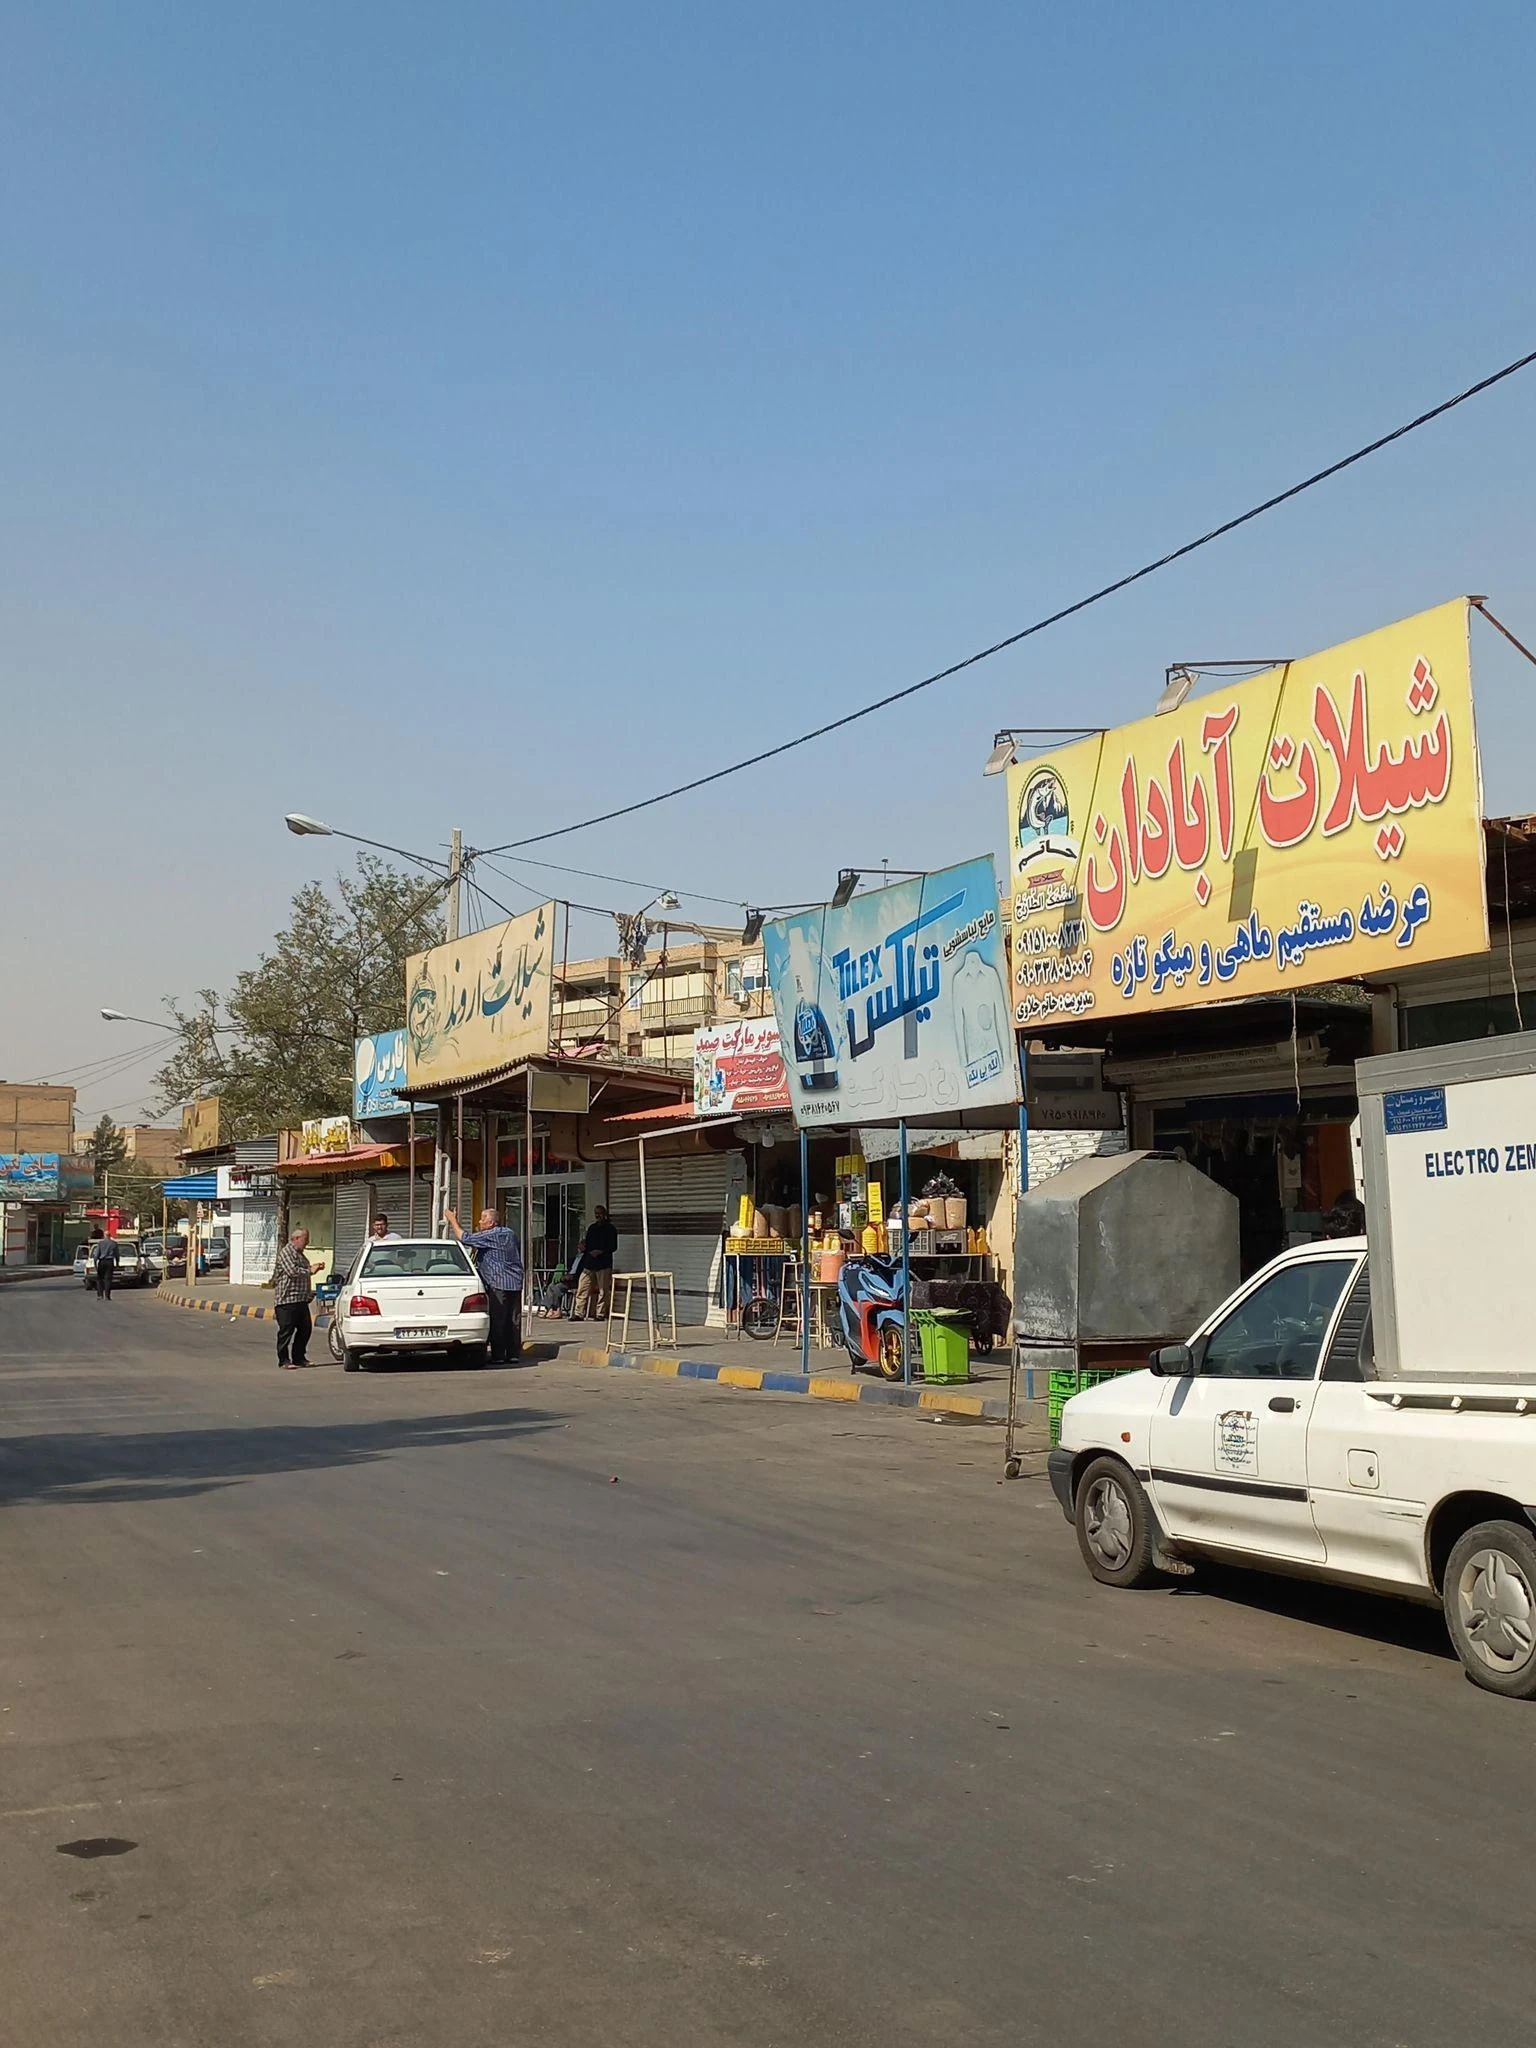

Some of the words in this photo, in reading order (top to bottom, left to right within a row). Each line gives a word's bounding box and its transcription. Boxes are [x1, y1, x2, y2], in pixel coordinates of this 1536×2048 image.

[1259, 656, 1451, 858] شیلات
[1086, 703, 1239, 930] آبادان
[1019, 839, 1077, 872] حاتم
[977, 911, 995, 938] مایع
[1215, 912, 1271, 978] ماهی
[1279, 899, 1354, 968] مستقیم
[1358, 884, 1430, 946] عرضه
[482, 908, 546, 1020] شیلات
[833, 943, 882, 1001] TILEX
[1111, 936, 1148, 997] تازه
[1151, 931, 1194, 993] میگو
[1198, 944, 1211, 984] و
[443, 957, 482, 1030] اروند
[722, 1026, 755, 1052] مارکت
[755, 1028, 781, 1050] سوپر
[1425, 1148, 1499, 1177] ELECTRO
